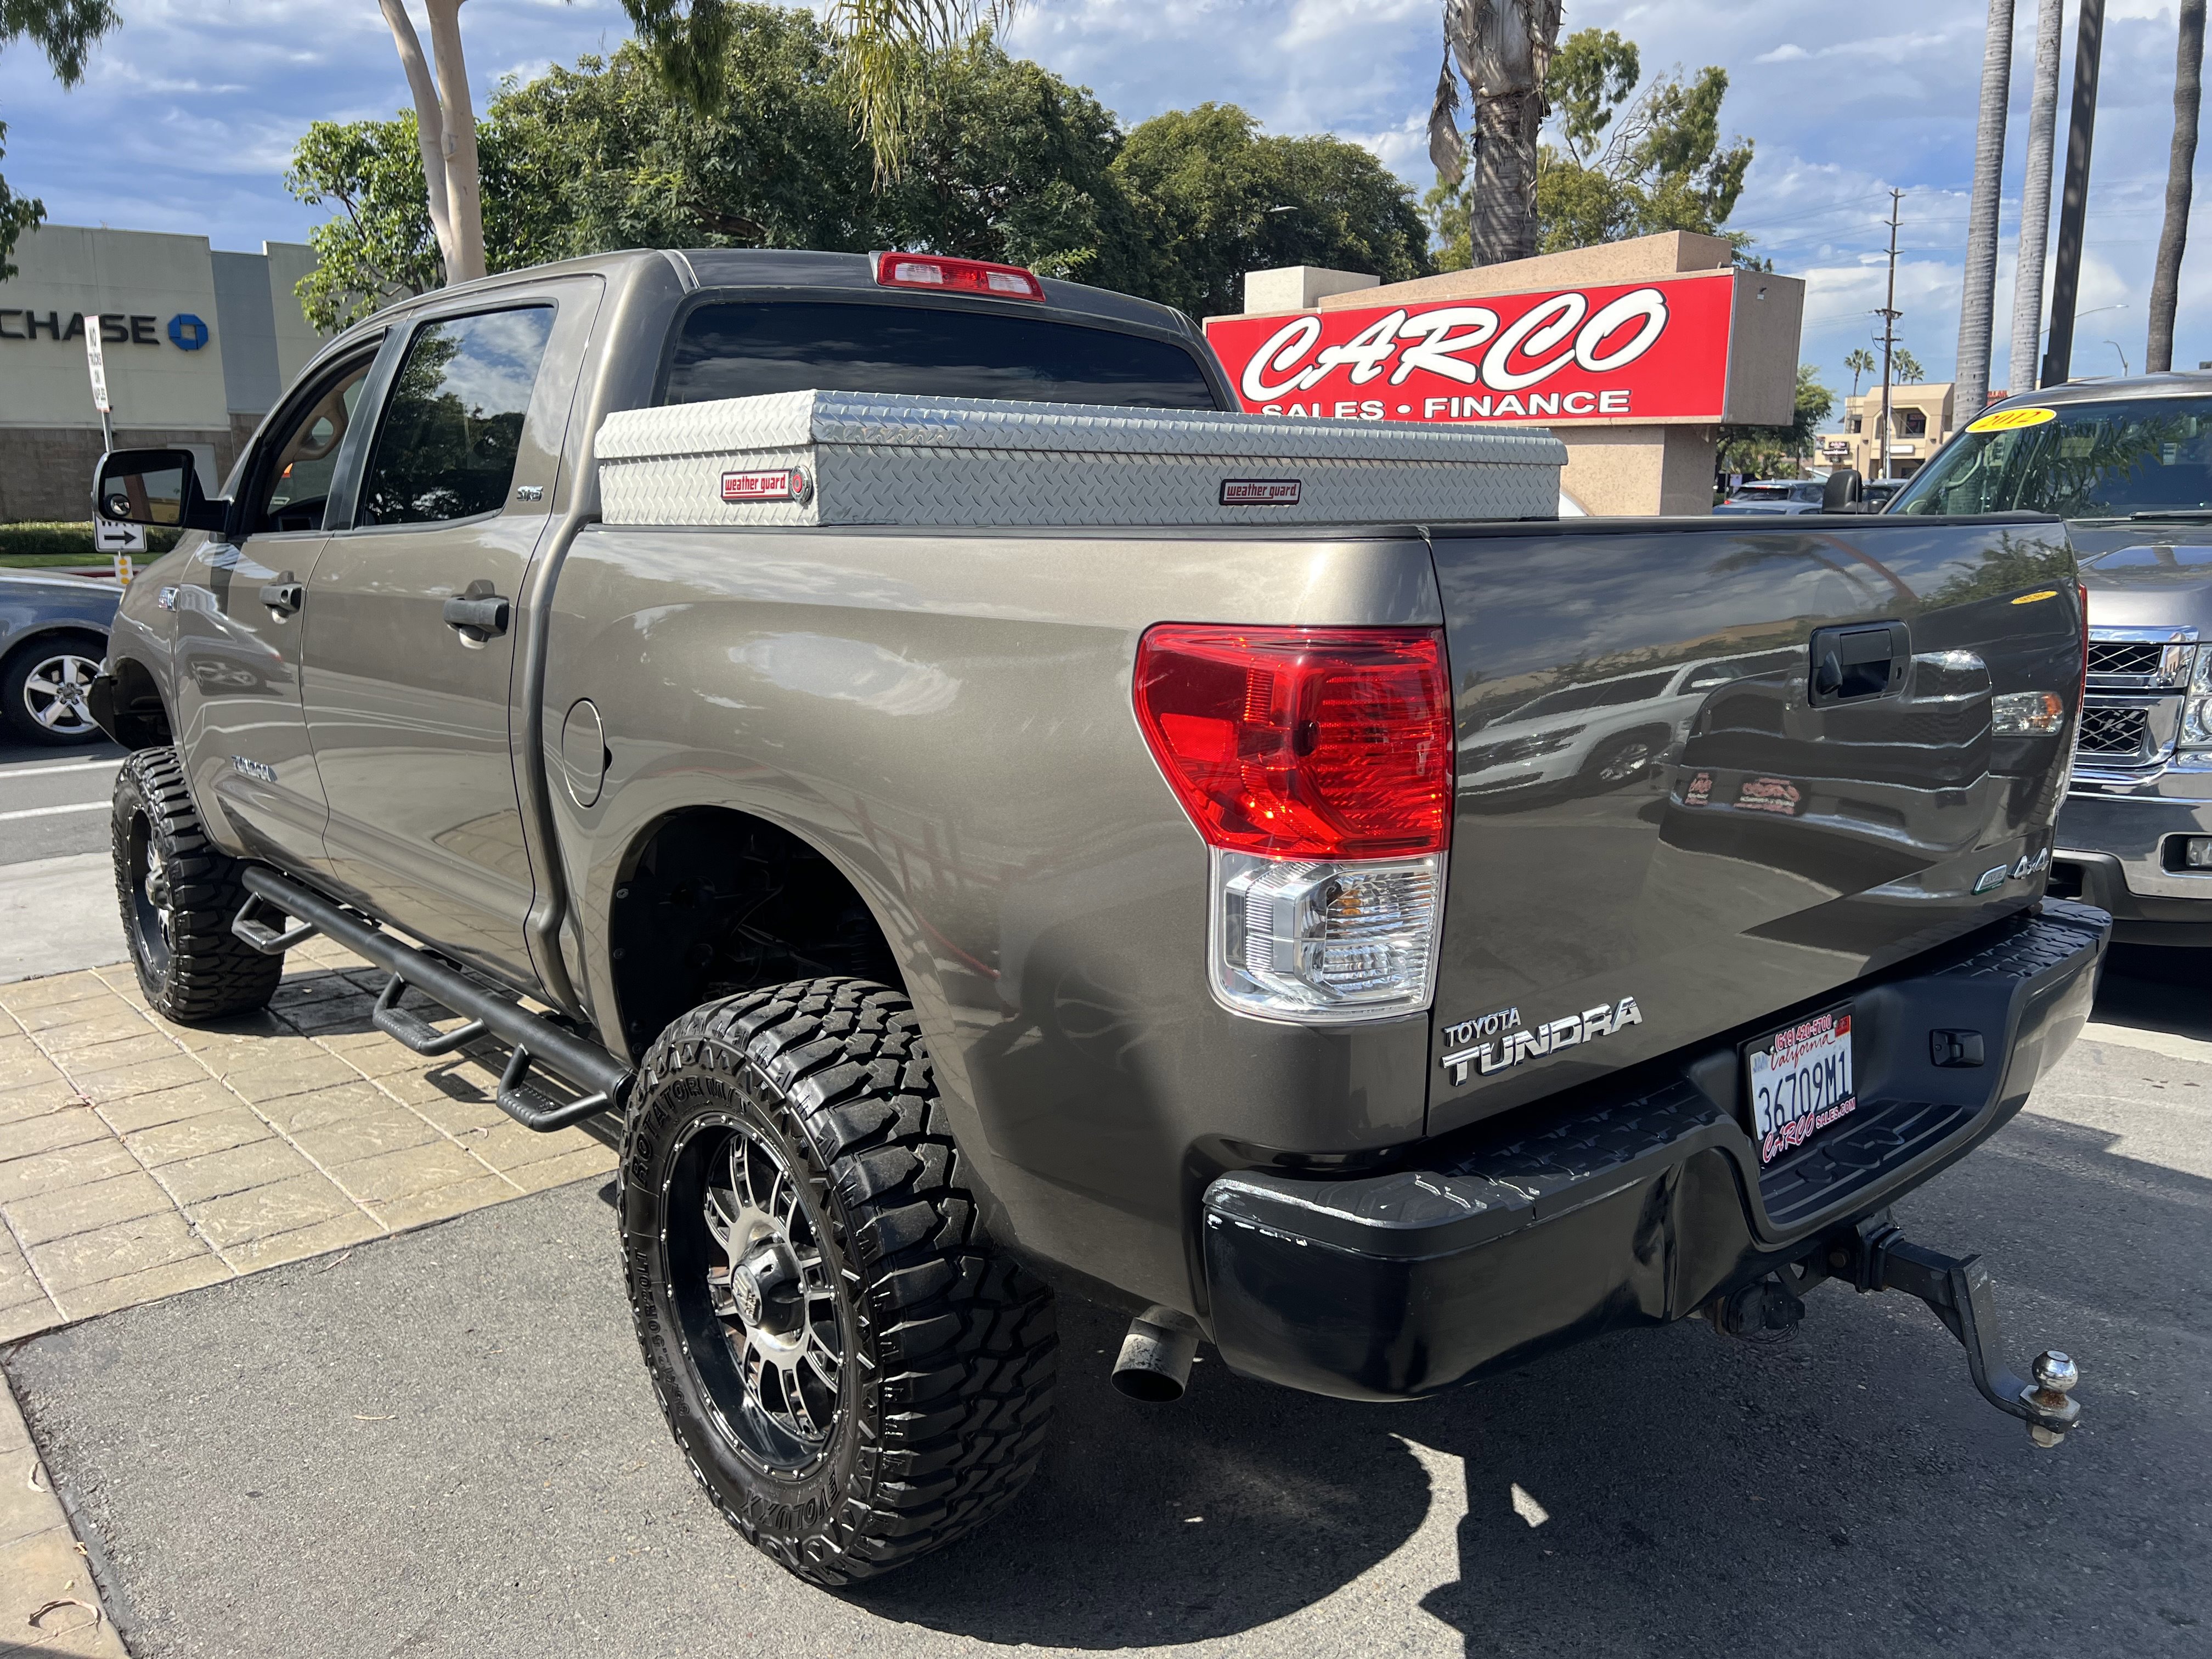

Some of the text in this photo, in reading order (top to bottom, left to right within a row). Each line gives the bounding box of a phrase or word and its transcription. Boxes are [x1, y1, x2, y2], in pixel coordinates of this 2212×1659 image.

[0, 308, 160, 346] CHASE
[89, 327, 97, 347] NO
[1240, 287, 1669, 403] CARCO
[1424, 389, 1632, 419] FINANCE
[1976, 411, 2041, 428] 2012
[725, 475, 759, 491] weather
[761, 474, 786, 493] guard
[1227, 483, 1297, 499] weather guard
[1441, 995, 1643, 1087] TUNDRA
[1444, 1006, 1521, 1047] TOYOTA
[1775, 1028, 1796, 1052] (619)
[1796, 1014, 1832, 1042] 420-5700
[1770, 1032, 1836, 1070] California
[1758, 1050, 1850, 1133] 36709M1
[631, 1075, 704, 1188] ROTATOR
[1763, 1097, 1856, 1163] CARCO SALES.COM
[740, 1465, 840, 1532] EVOLUXX
